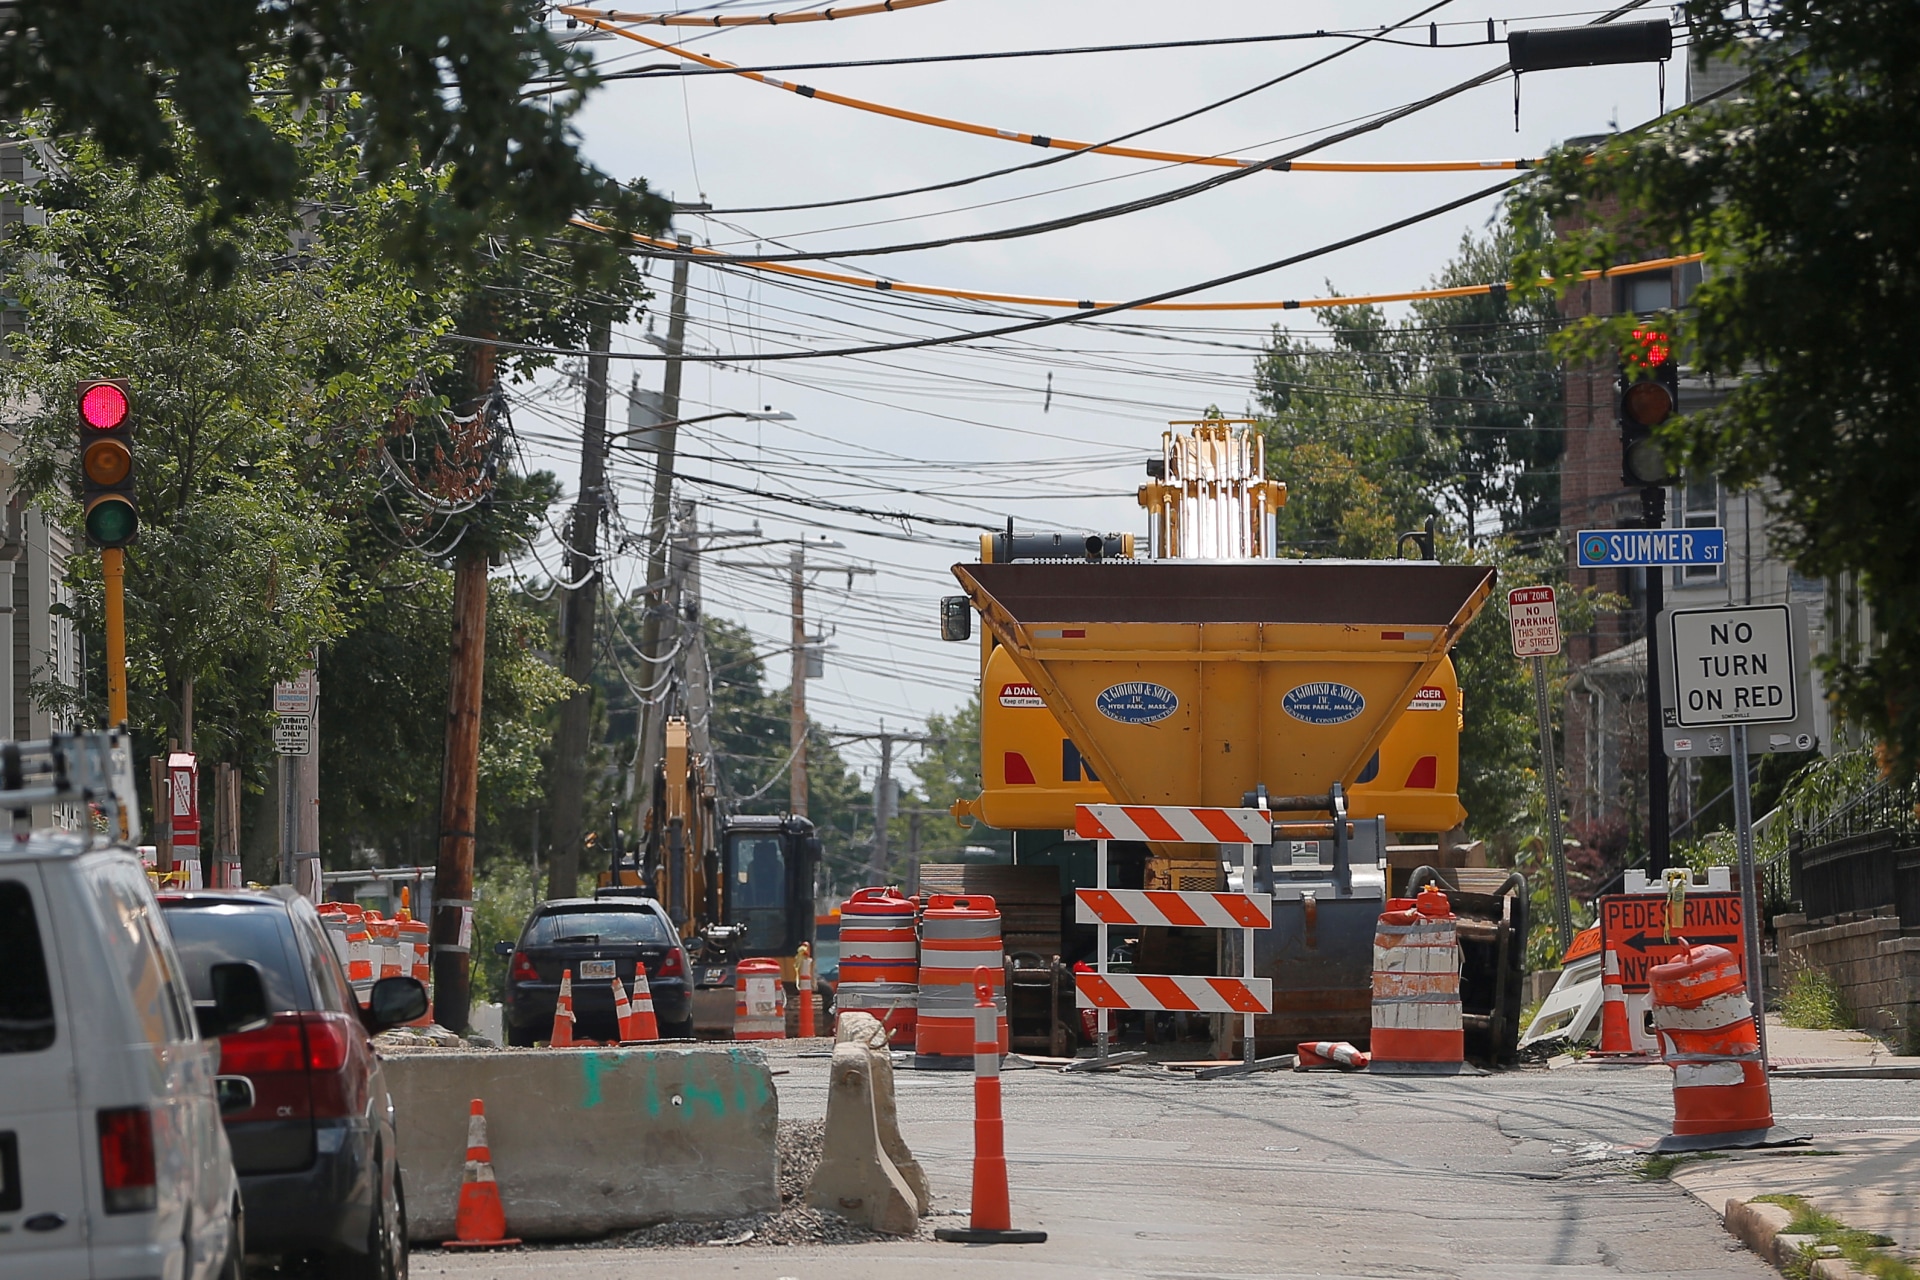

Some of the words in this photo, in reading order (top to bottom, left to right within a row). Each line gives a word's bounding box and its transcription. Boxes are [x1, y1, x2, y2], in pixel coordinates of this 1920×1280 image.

[1610, 534, 1694, 561] SUMMER
[1704, 546, 1719, 560] ST
[1514, 592, 1528, 602] TOW
[1532, 591, 1549, 601] ZONE
[1526, 606, 1540, 616] NO
[1514, 616, 1554, 628] PARKING
[1518, 628, 1533, 638] THIS
[1537, 627, 1553, 637] SIDE
[1711, 622, 1753, 645] NO
[1518, 639, 1526, 648] OF
[1530, 637, 1554, 648] STREET
[1699, 653, 1768, 678] TURN
[1101, 693, 1113, 703] P.
[1109, 684, 1143, 699] GIOIOSO
[1144, 684, 1152, 696] &
[1152, 686, 1174, 703] SONS
[1287, 693, 1299, 703] P.
[1295, 684, 1329, 699] GIOIOSO
[1330, 684, 1338, 696] &
[1339, 686, 1359, 704] SONS
[1415, 689, 1441, 699] NGER
[1688, 689, 1722, 711] ON
[1735, 685, 1783, 708] RED
[1099, 704, 1126, 721] GENERAL
[1129, 705, 1176, 723] CONSTRUCTION
[1285, 705, 1312, 722] GENERAL
[1315, 704, 1362, 723] CONSTRUCTION
[1608, 900, 1742, 930] PEDESRIANS
